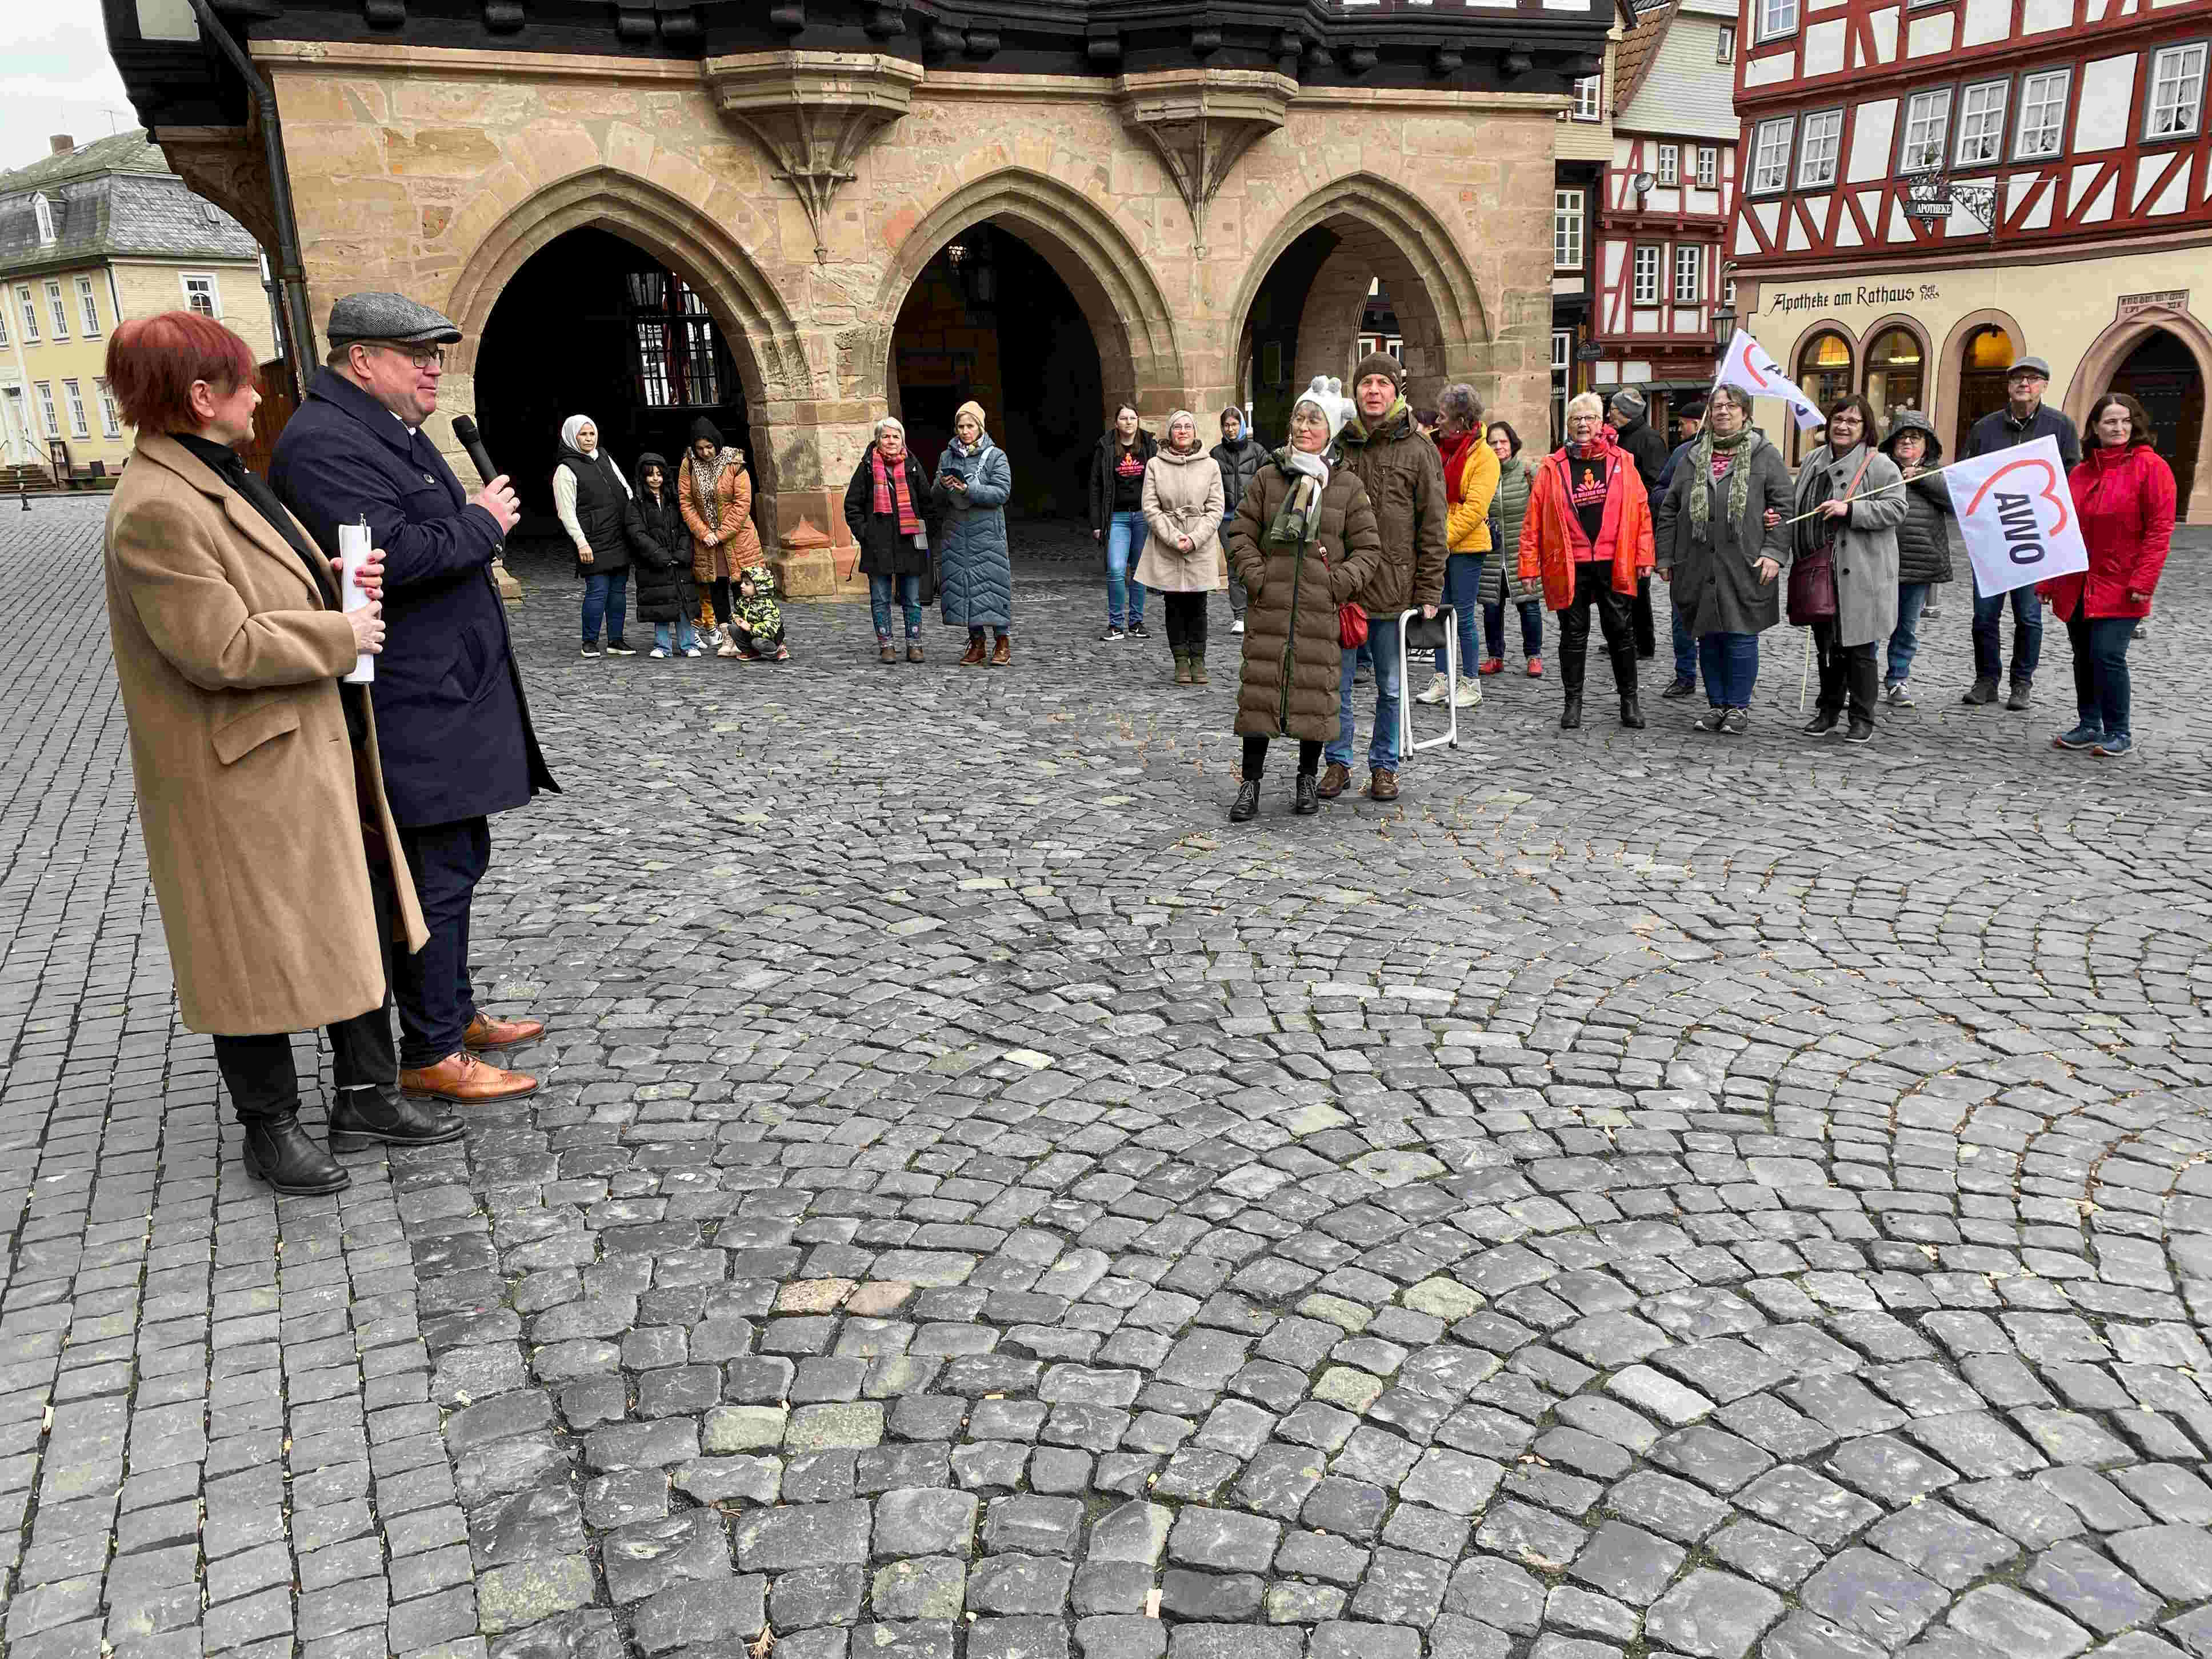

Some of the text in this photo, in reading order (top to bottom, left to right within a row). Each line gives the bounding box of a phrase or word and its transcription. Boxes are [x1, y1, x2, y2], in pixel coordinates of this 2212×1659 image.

[1917, 203, 1951, 214] APOTHEKE
[1763, 285, 1915, 316] Apotheke am Rathaus
[1993, 493, 2045, 565] AWO
